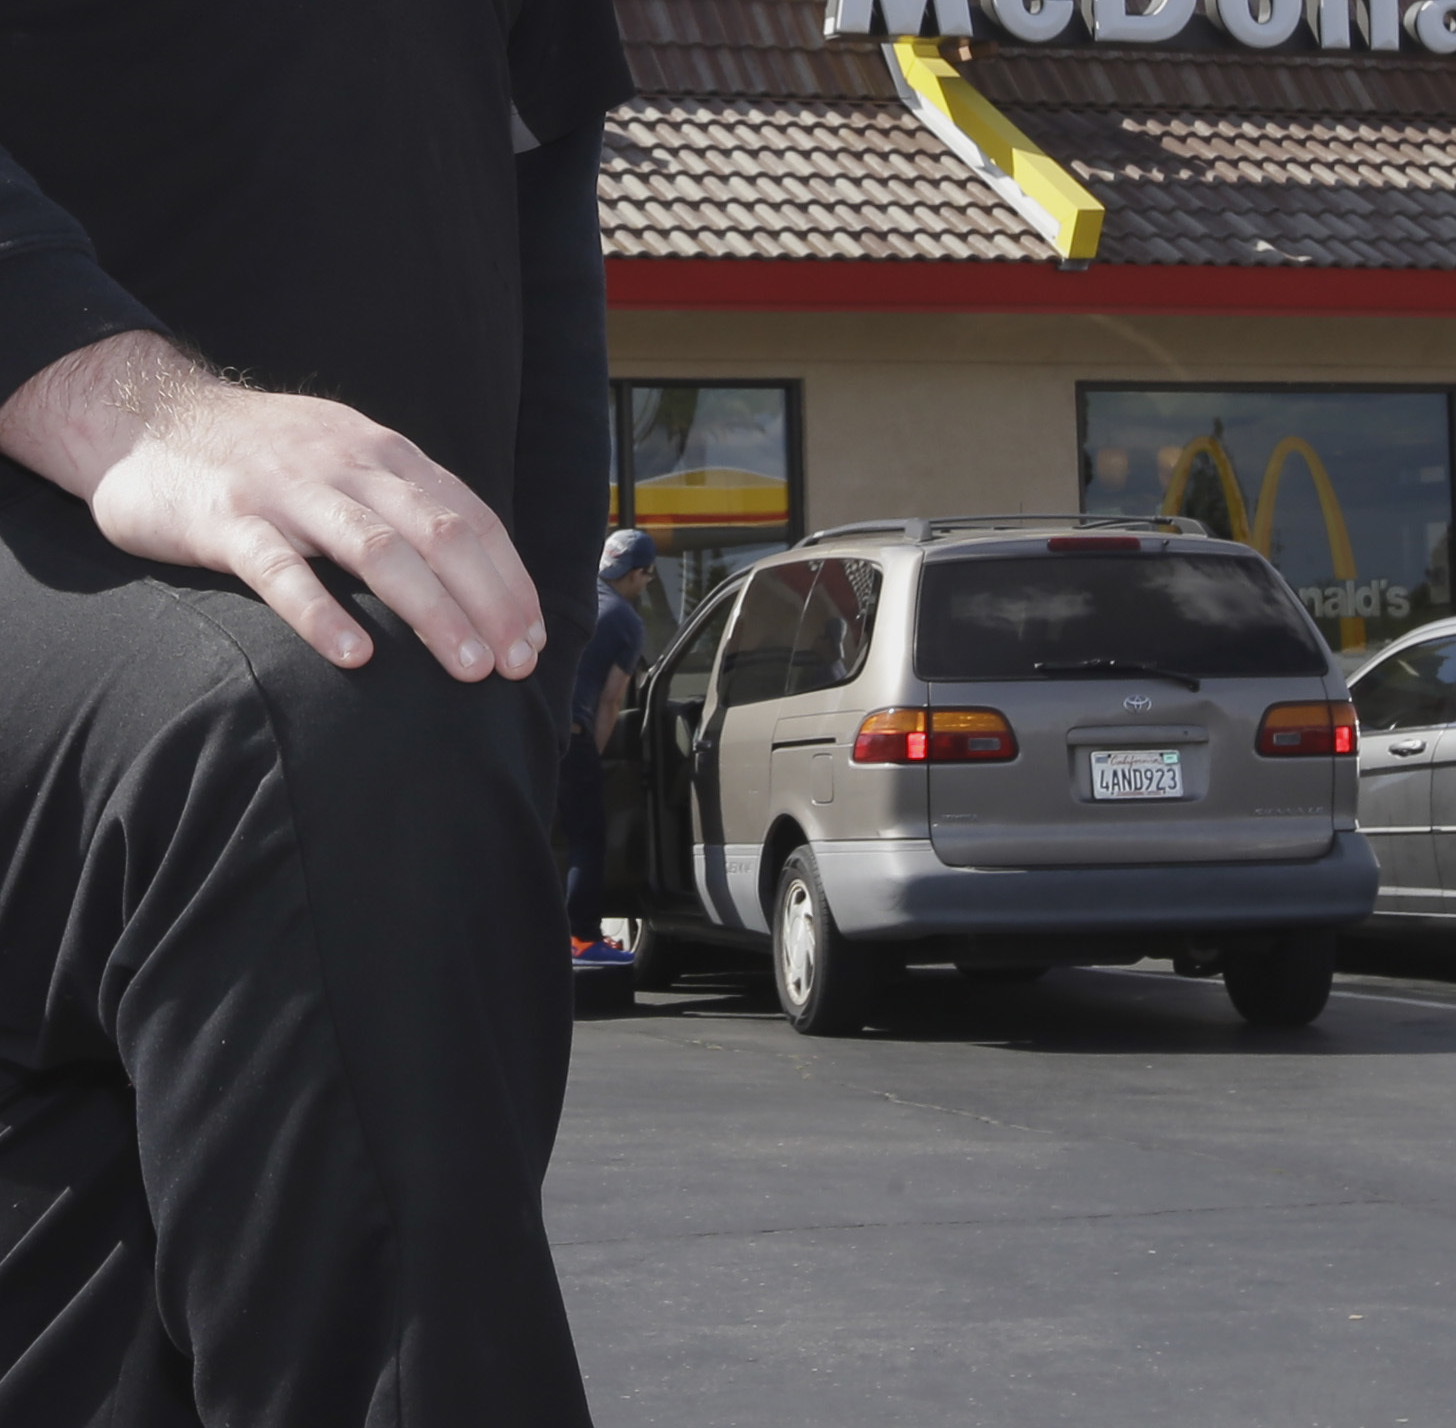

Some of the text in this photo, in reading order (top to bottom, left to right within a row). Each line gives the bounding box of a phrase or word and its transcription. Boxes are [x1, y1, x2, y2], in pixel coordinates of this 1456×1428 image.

[1298, 578, 1411, 618] nald's
[1110, 753, 1161, 769] California
[1099, 768, 1178, 791] 4AND923
